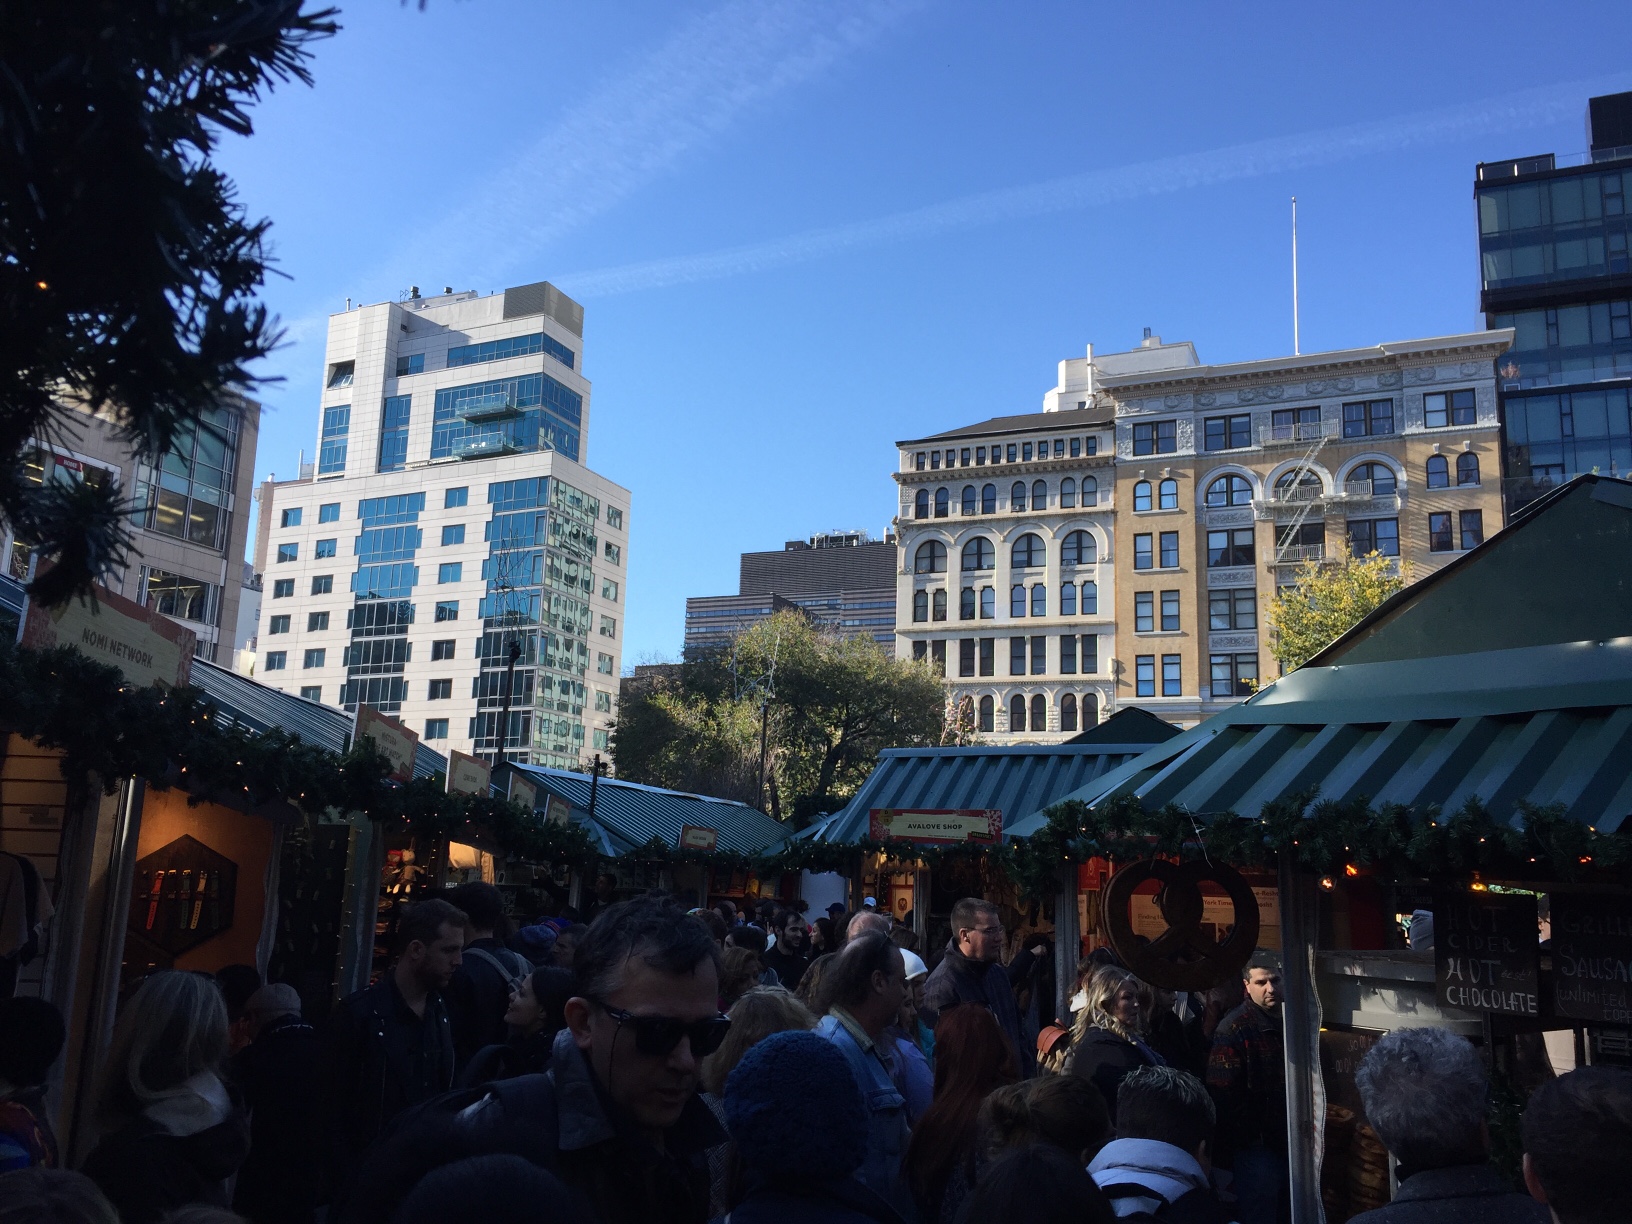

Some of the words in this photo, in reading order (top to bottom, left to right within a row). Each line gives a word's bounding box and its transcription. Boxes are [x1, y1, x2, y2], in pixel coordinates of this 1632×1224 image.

[82, 628, 107, 650] NOMI
[110, 641, 153, 668] NETWORK
[1446, 905, 1506, 932] HOT
[1448, 933, 1518, 953] CIDER
[1445, 957, 1501, 986] HOT
[1445, 985, 1539, 1014] CHOCOLATE
